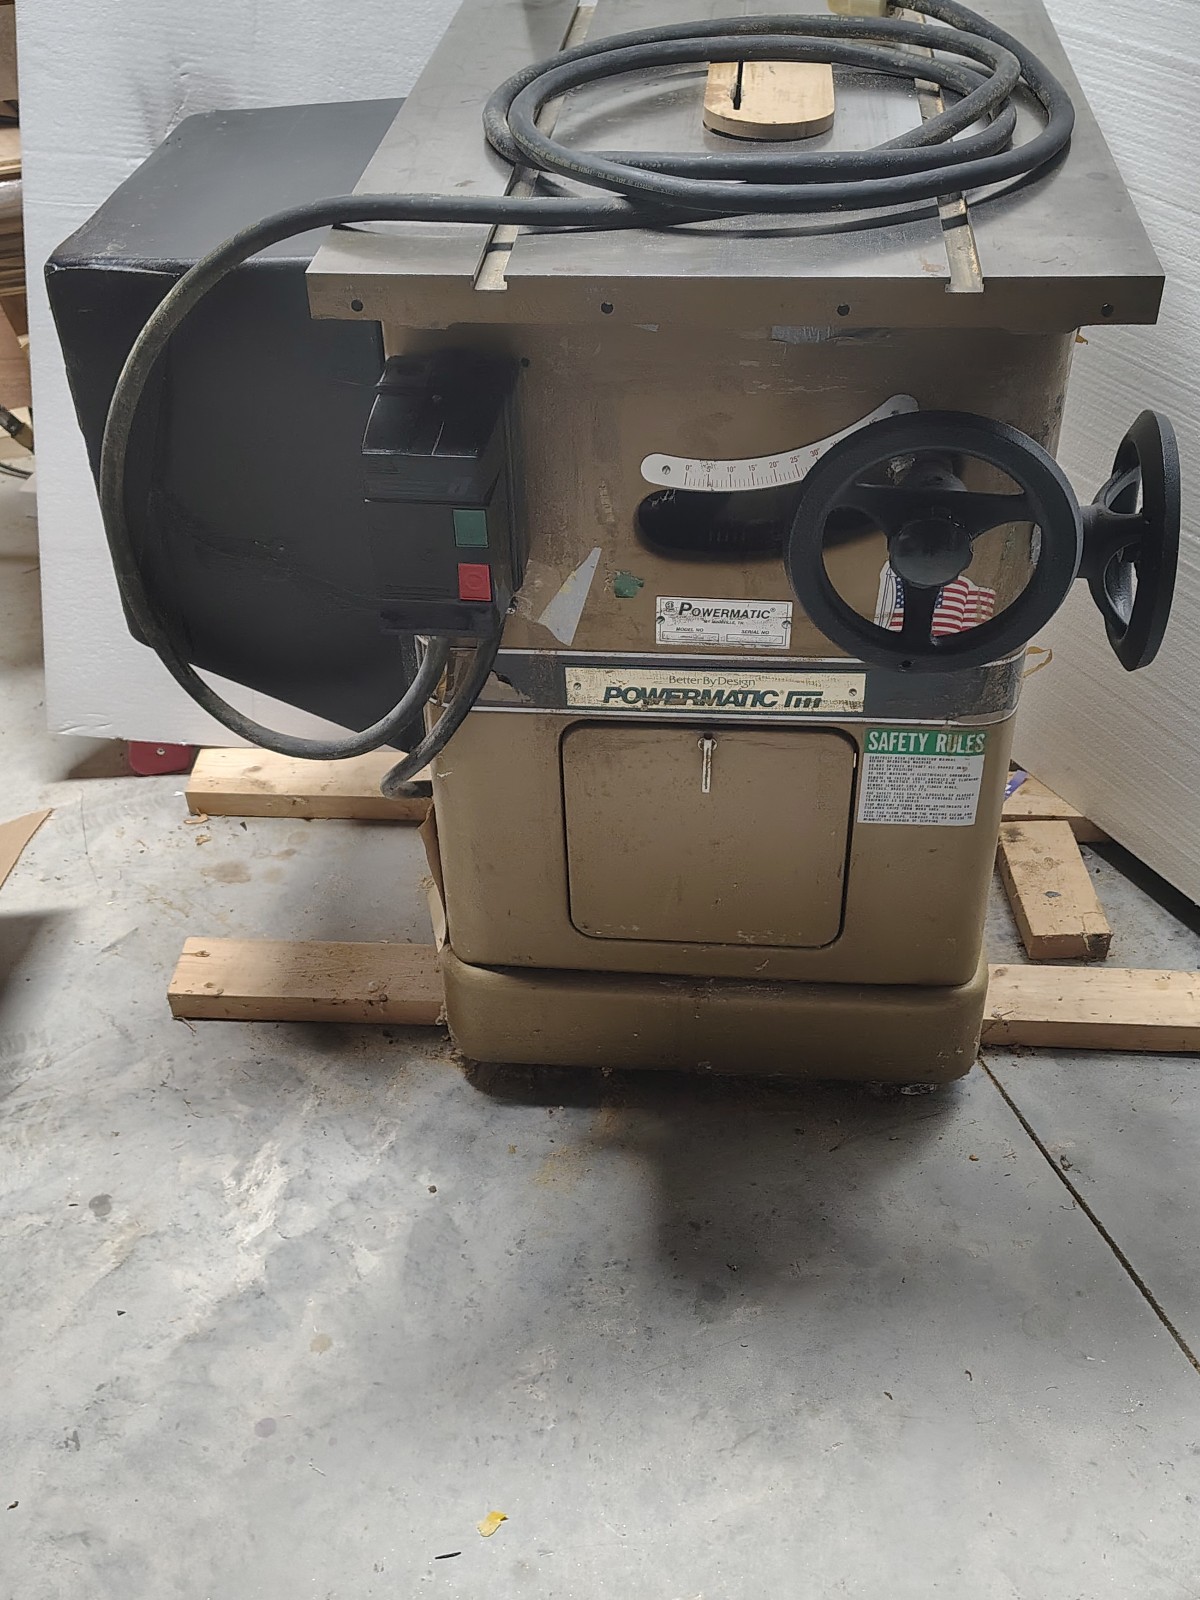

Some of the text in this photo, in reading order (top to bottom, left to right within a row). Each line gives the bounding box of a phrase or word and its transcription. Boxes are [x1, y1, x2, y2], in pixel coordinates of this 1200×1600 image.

[717, 677, 756, 688] Design
[868, 731, 986, 754] SAFETY RULES
